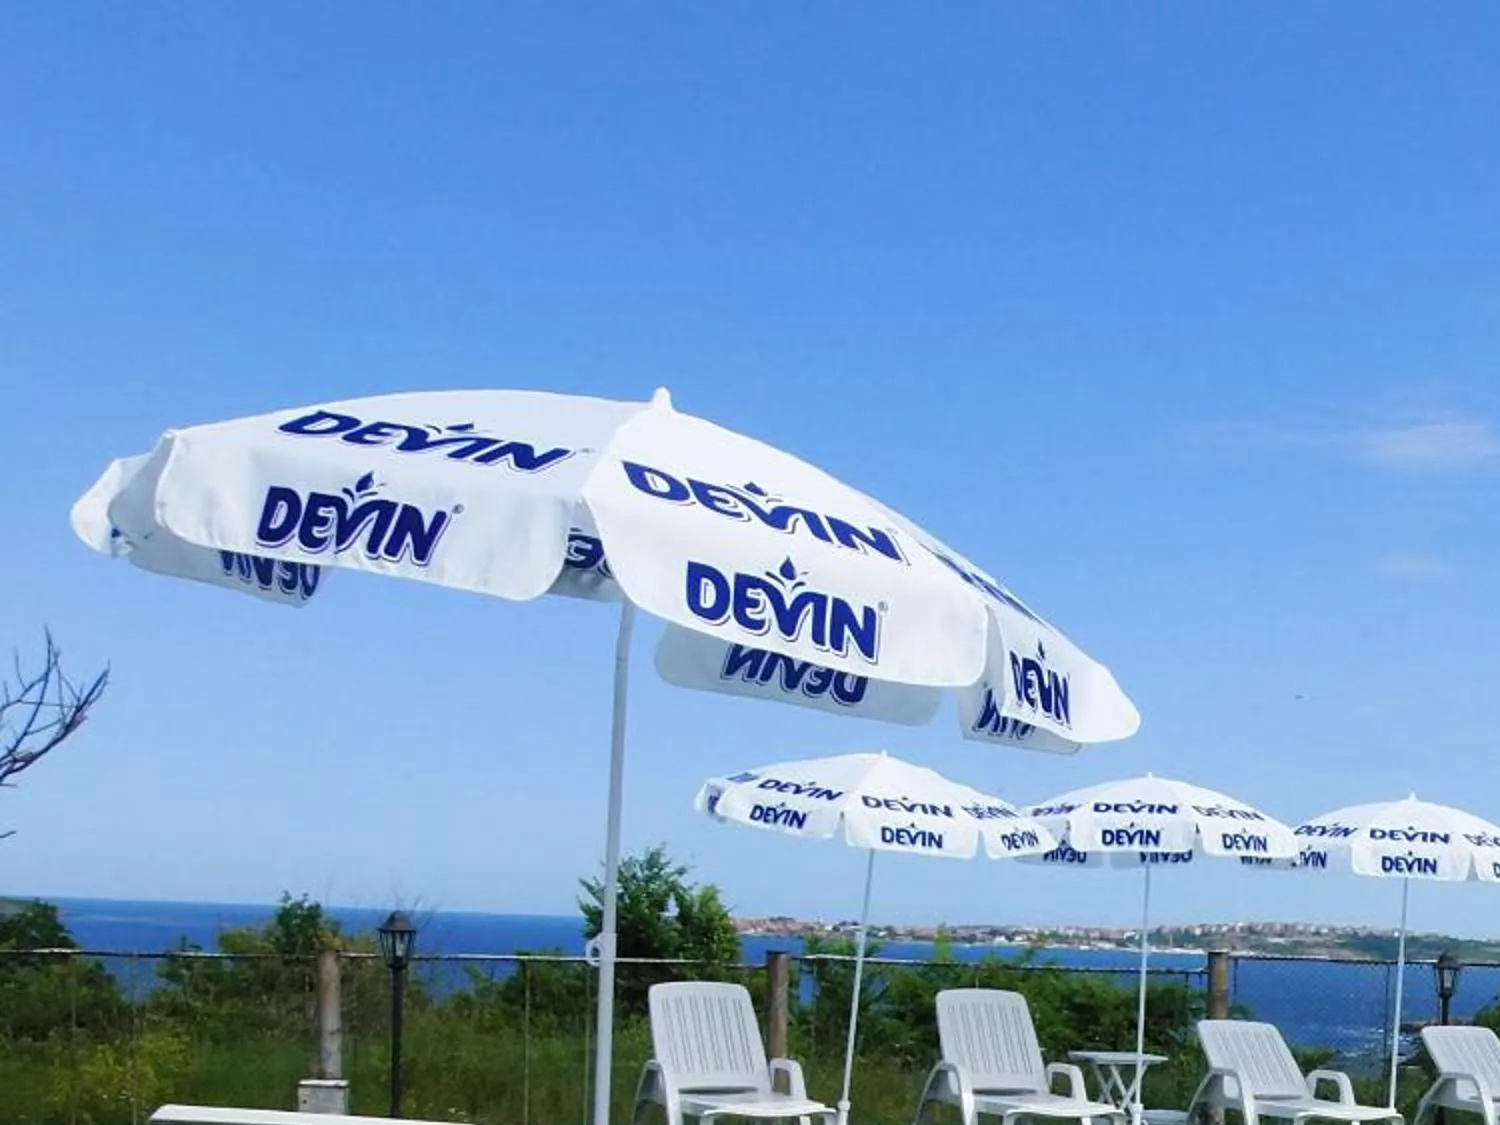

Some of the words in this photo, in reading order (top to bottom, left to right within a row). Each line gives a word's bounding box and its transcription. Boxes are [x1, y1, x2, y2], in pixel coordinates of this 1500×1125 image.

[277, 410, 576, 473] DEVIN
[622, 460, 910, 566] DEVIN
[256, 485, 450, 566] DEVIN
[685, 560, 881, 664] DEVIN
[758, 779, 844, 801] DEVIN
[749, 804, 807, 829] DEVIN
[862, 796, 953, 818] DEVIN
[1093, 802, 1178, 814] DEVIN
[881, 826, 943, 849] DEVIN
[1101, 829, 1161, 846] DEVIN
[1222, 833, 1267, 852] DEVIN
[1369, 828, 1450, 844] DEVIN
[1381, 856, 1438, 875] DEVIN
